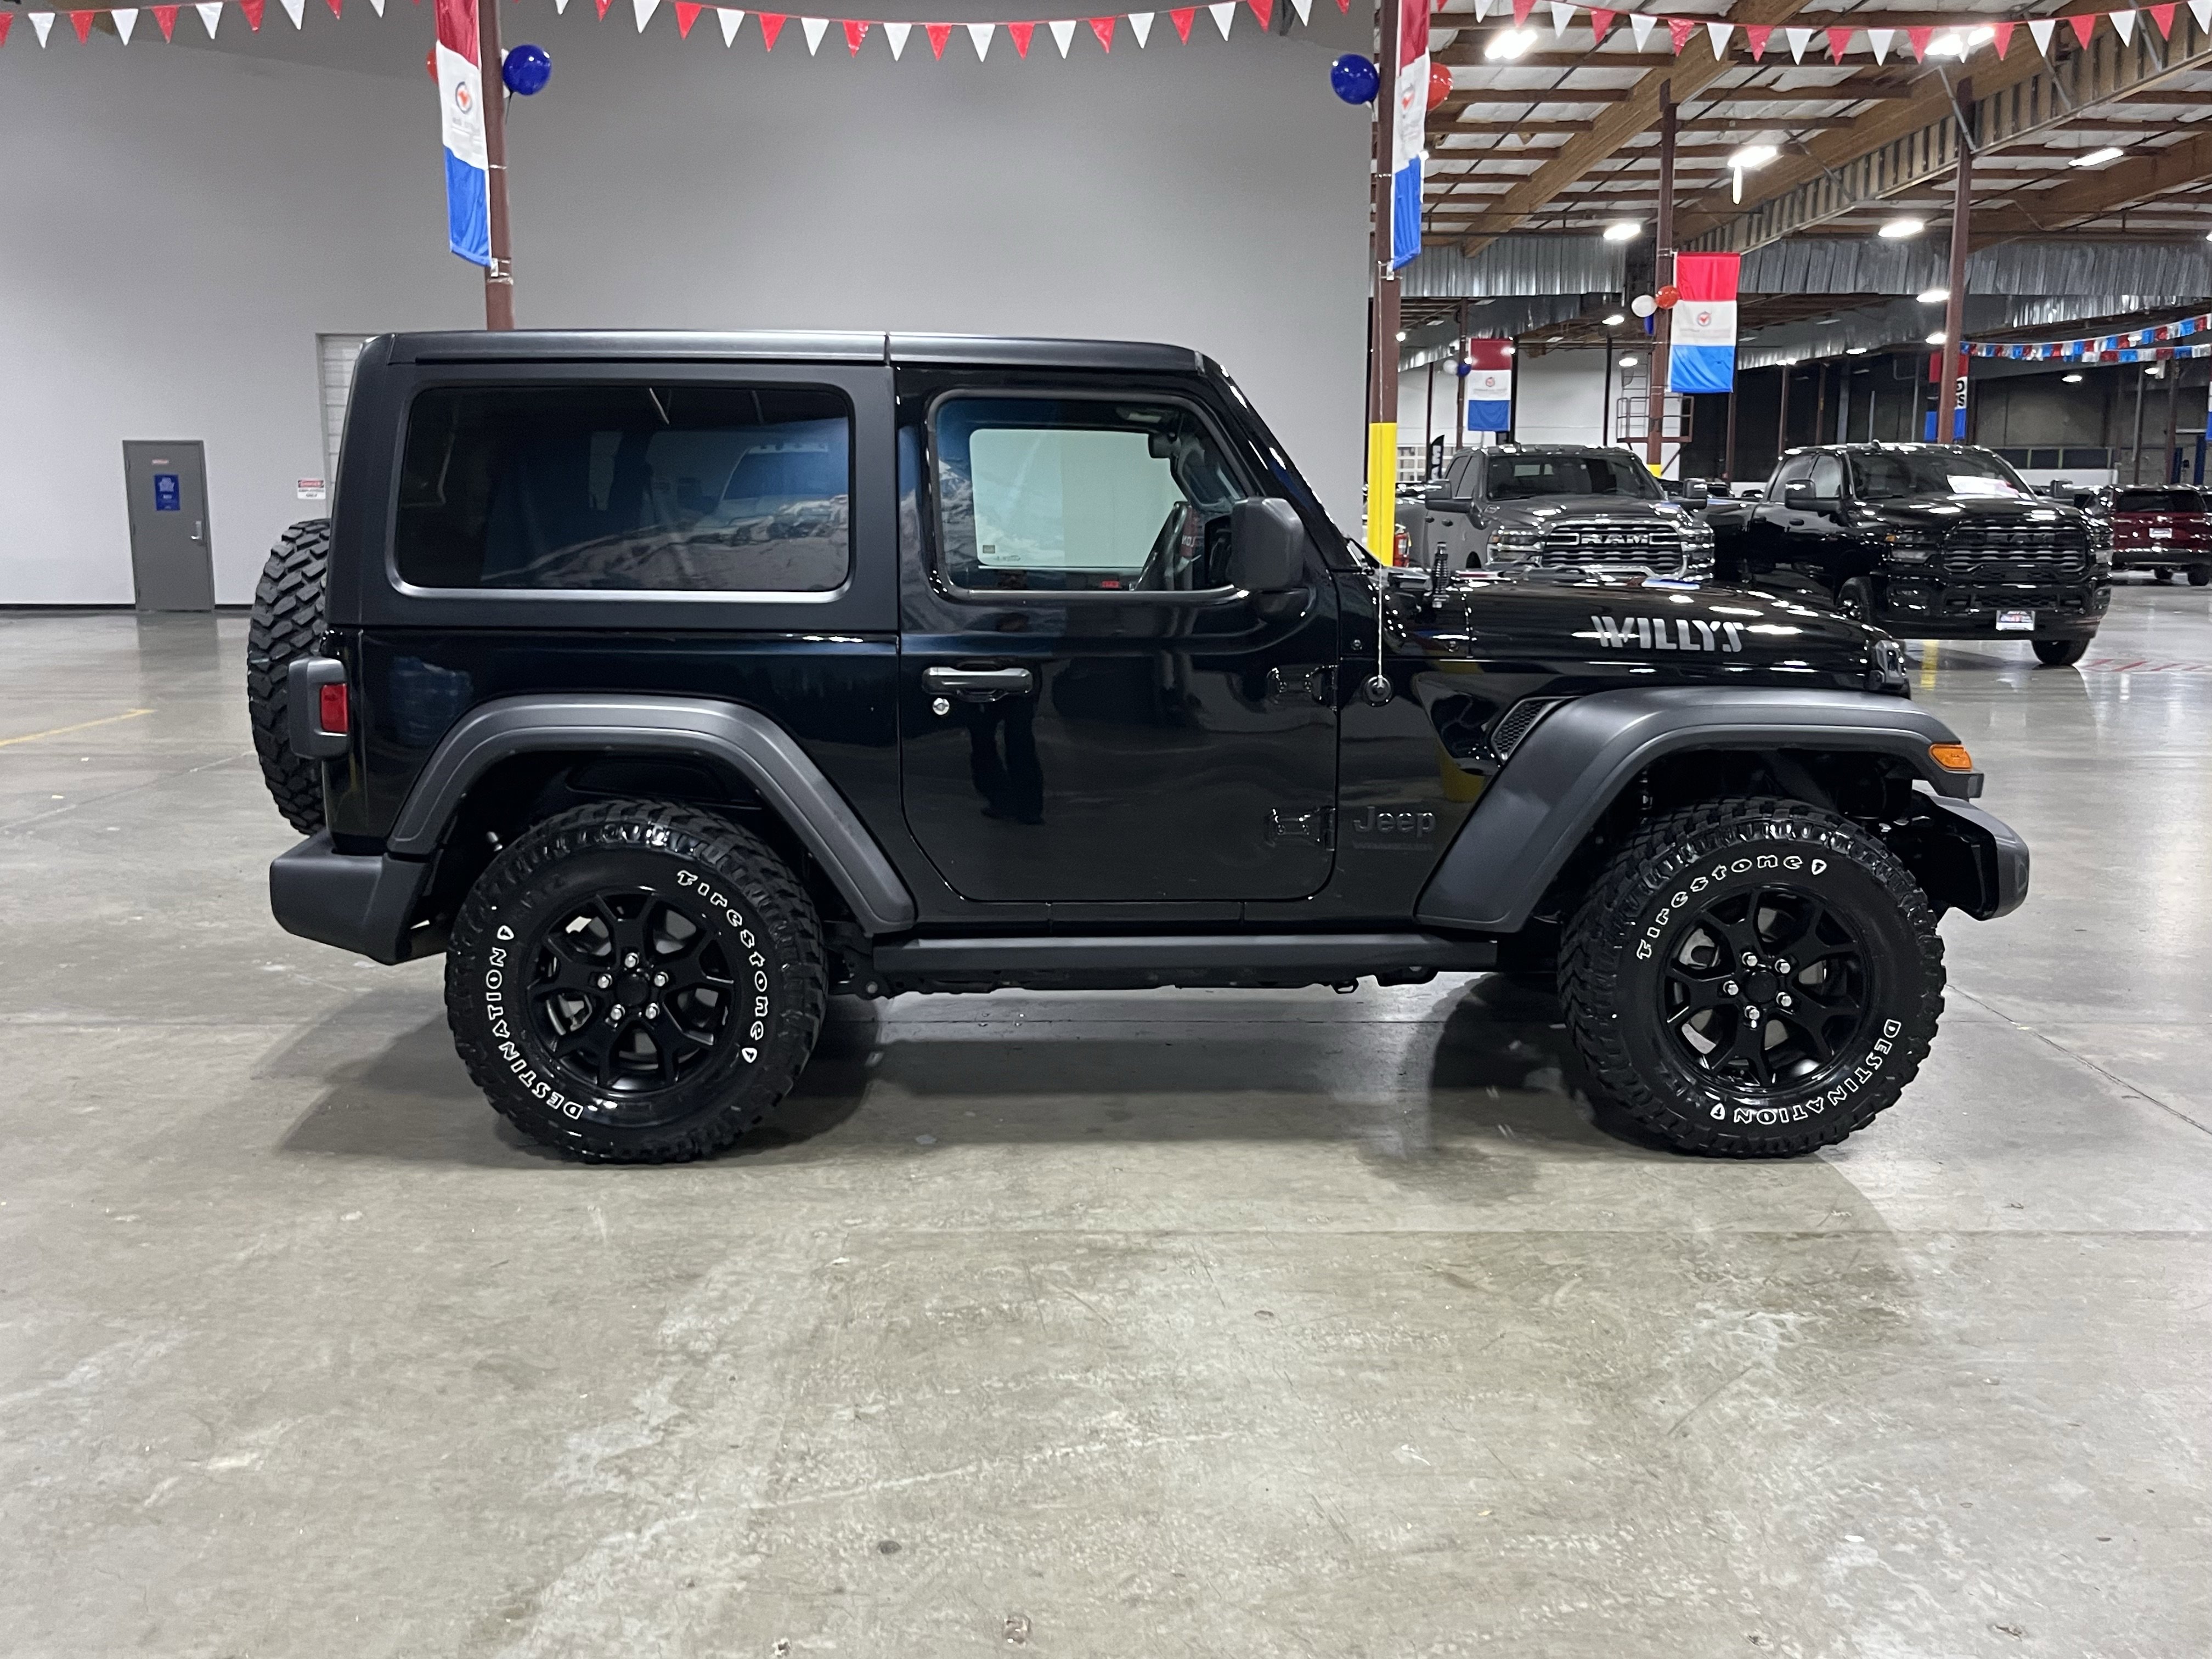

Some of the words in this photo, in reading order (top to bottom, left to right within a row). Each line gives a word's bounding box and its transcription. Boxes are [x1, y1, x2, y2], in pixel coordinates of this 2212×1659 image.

[1581, 533, 1648, 544] RAM
[1591, 616, 1744, 653] WILLYS
[1353, 806, 1436, 838] Jeep
[486, 947, 584, 1120] DESTINATION
[1734, 1019, 1901, 1125] DESTINATION
